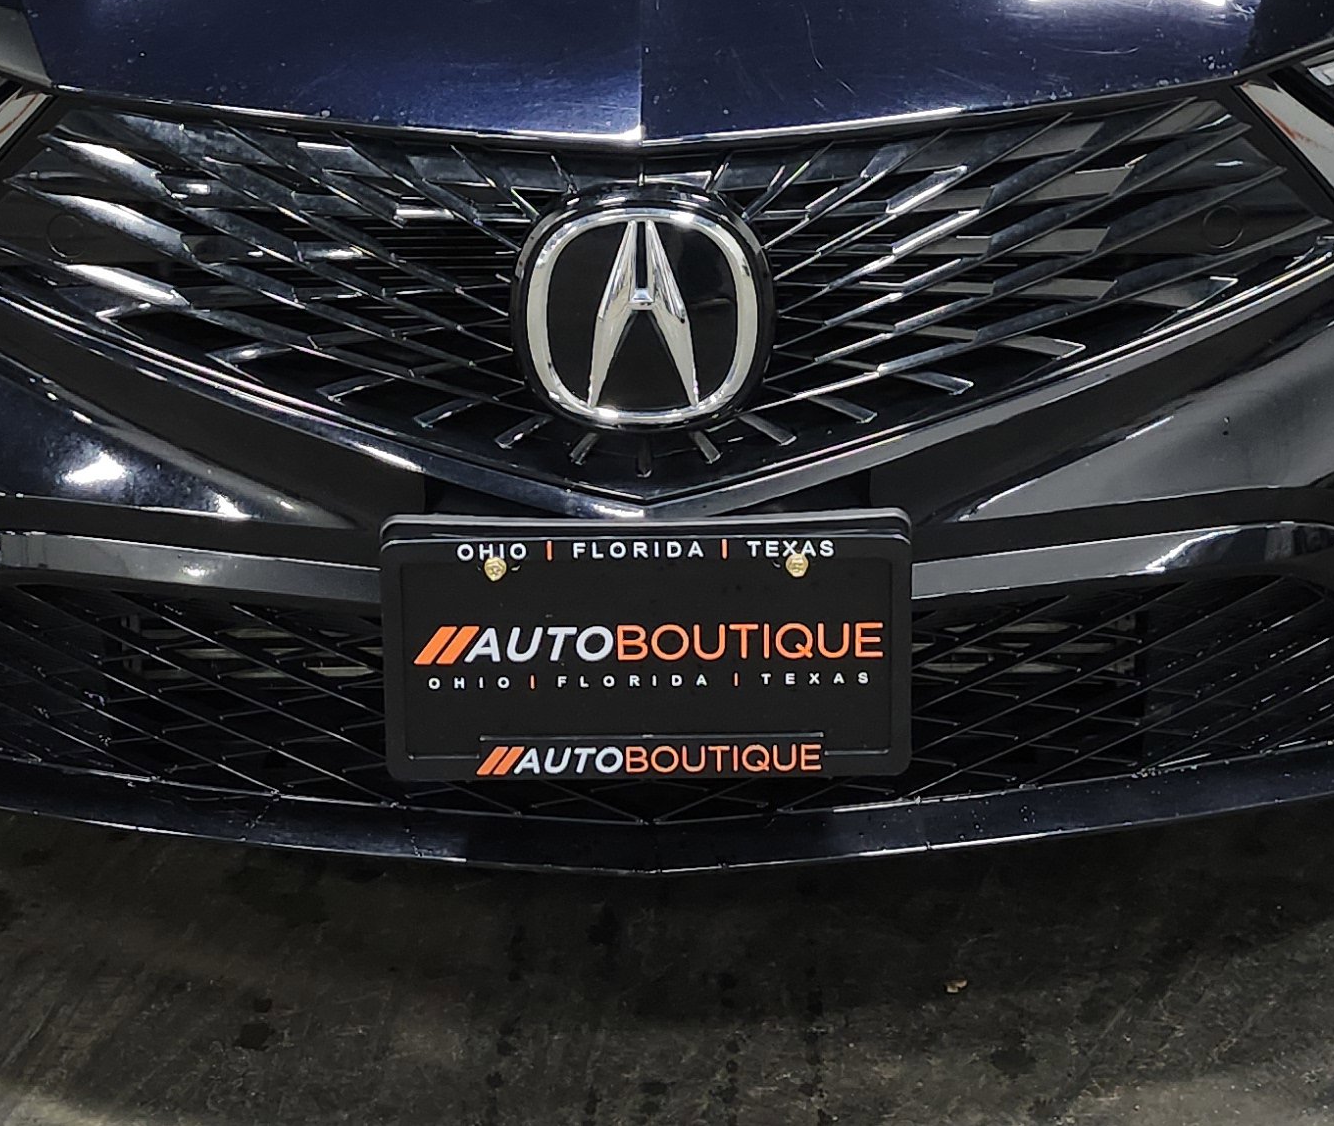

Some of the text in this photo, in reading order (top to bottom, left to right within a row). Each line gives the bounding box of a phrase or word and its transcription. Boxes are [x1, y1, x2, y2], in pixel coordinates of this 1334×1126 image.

[456, 539, 836, 562] OHIO FLORIDA TEXAS
[464, 621, 885, 663] AUTOBOUTIQUE
[427, 671, 870, 690] OHIO FLORIDA TEXAS
[513, 743, 824, 774] AUTOBOUTIQUE
